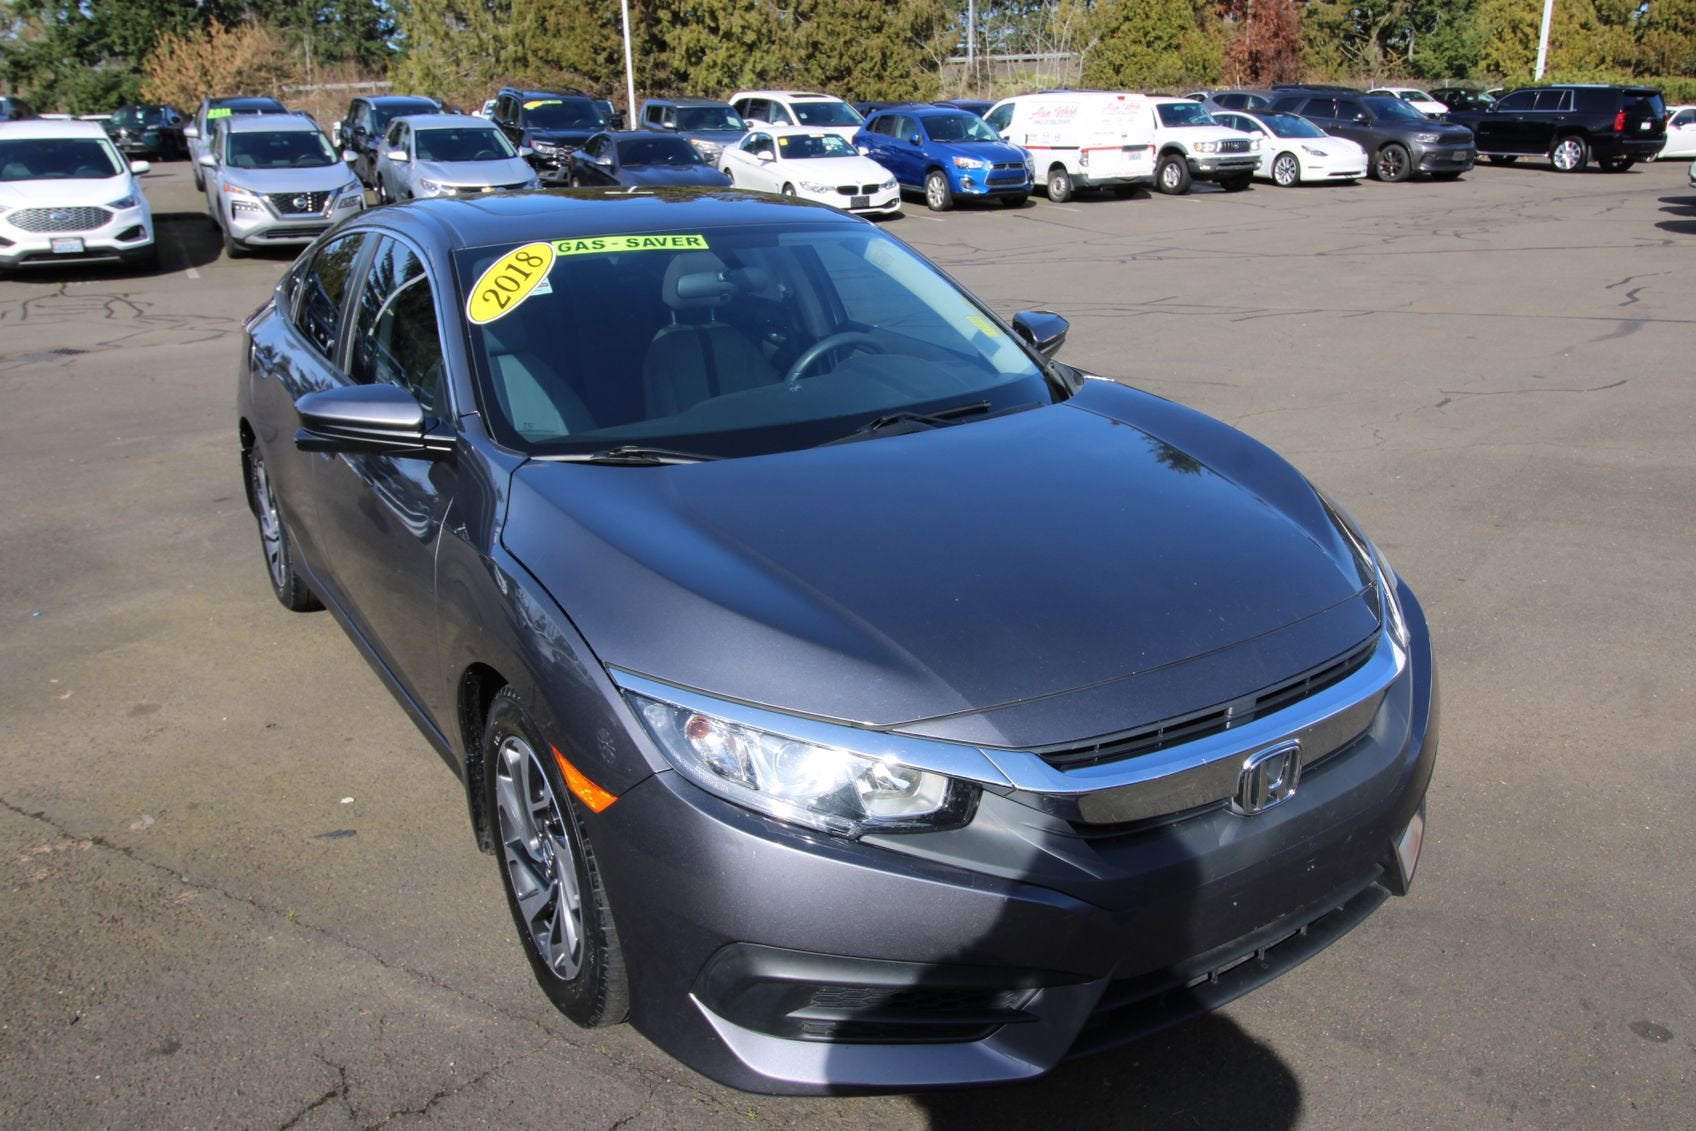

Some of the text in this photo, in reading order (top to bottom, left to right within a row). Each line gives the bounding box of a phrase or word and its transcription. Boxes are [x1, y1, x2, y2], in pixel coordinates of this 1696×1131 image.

[558, 239, 605, 253] GAS
[626, 236, 702, 248] SAVER
[482, 251, 543, 309] 2018
